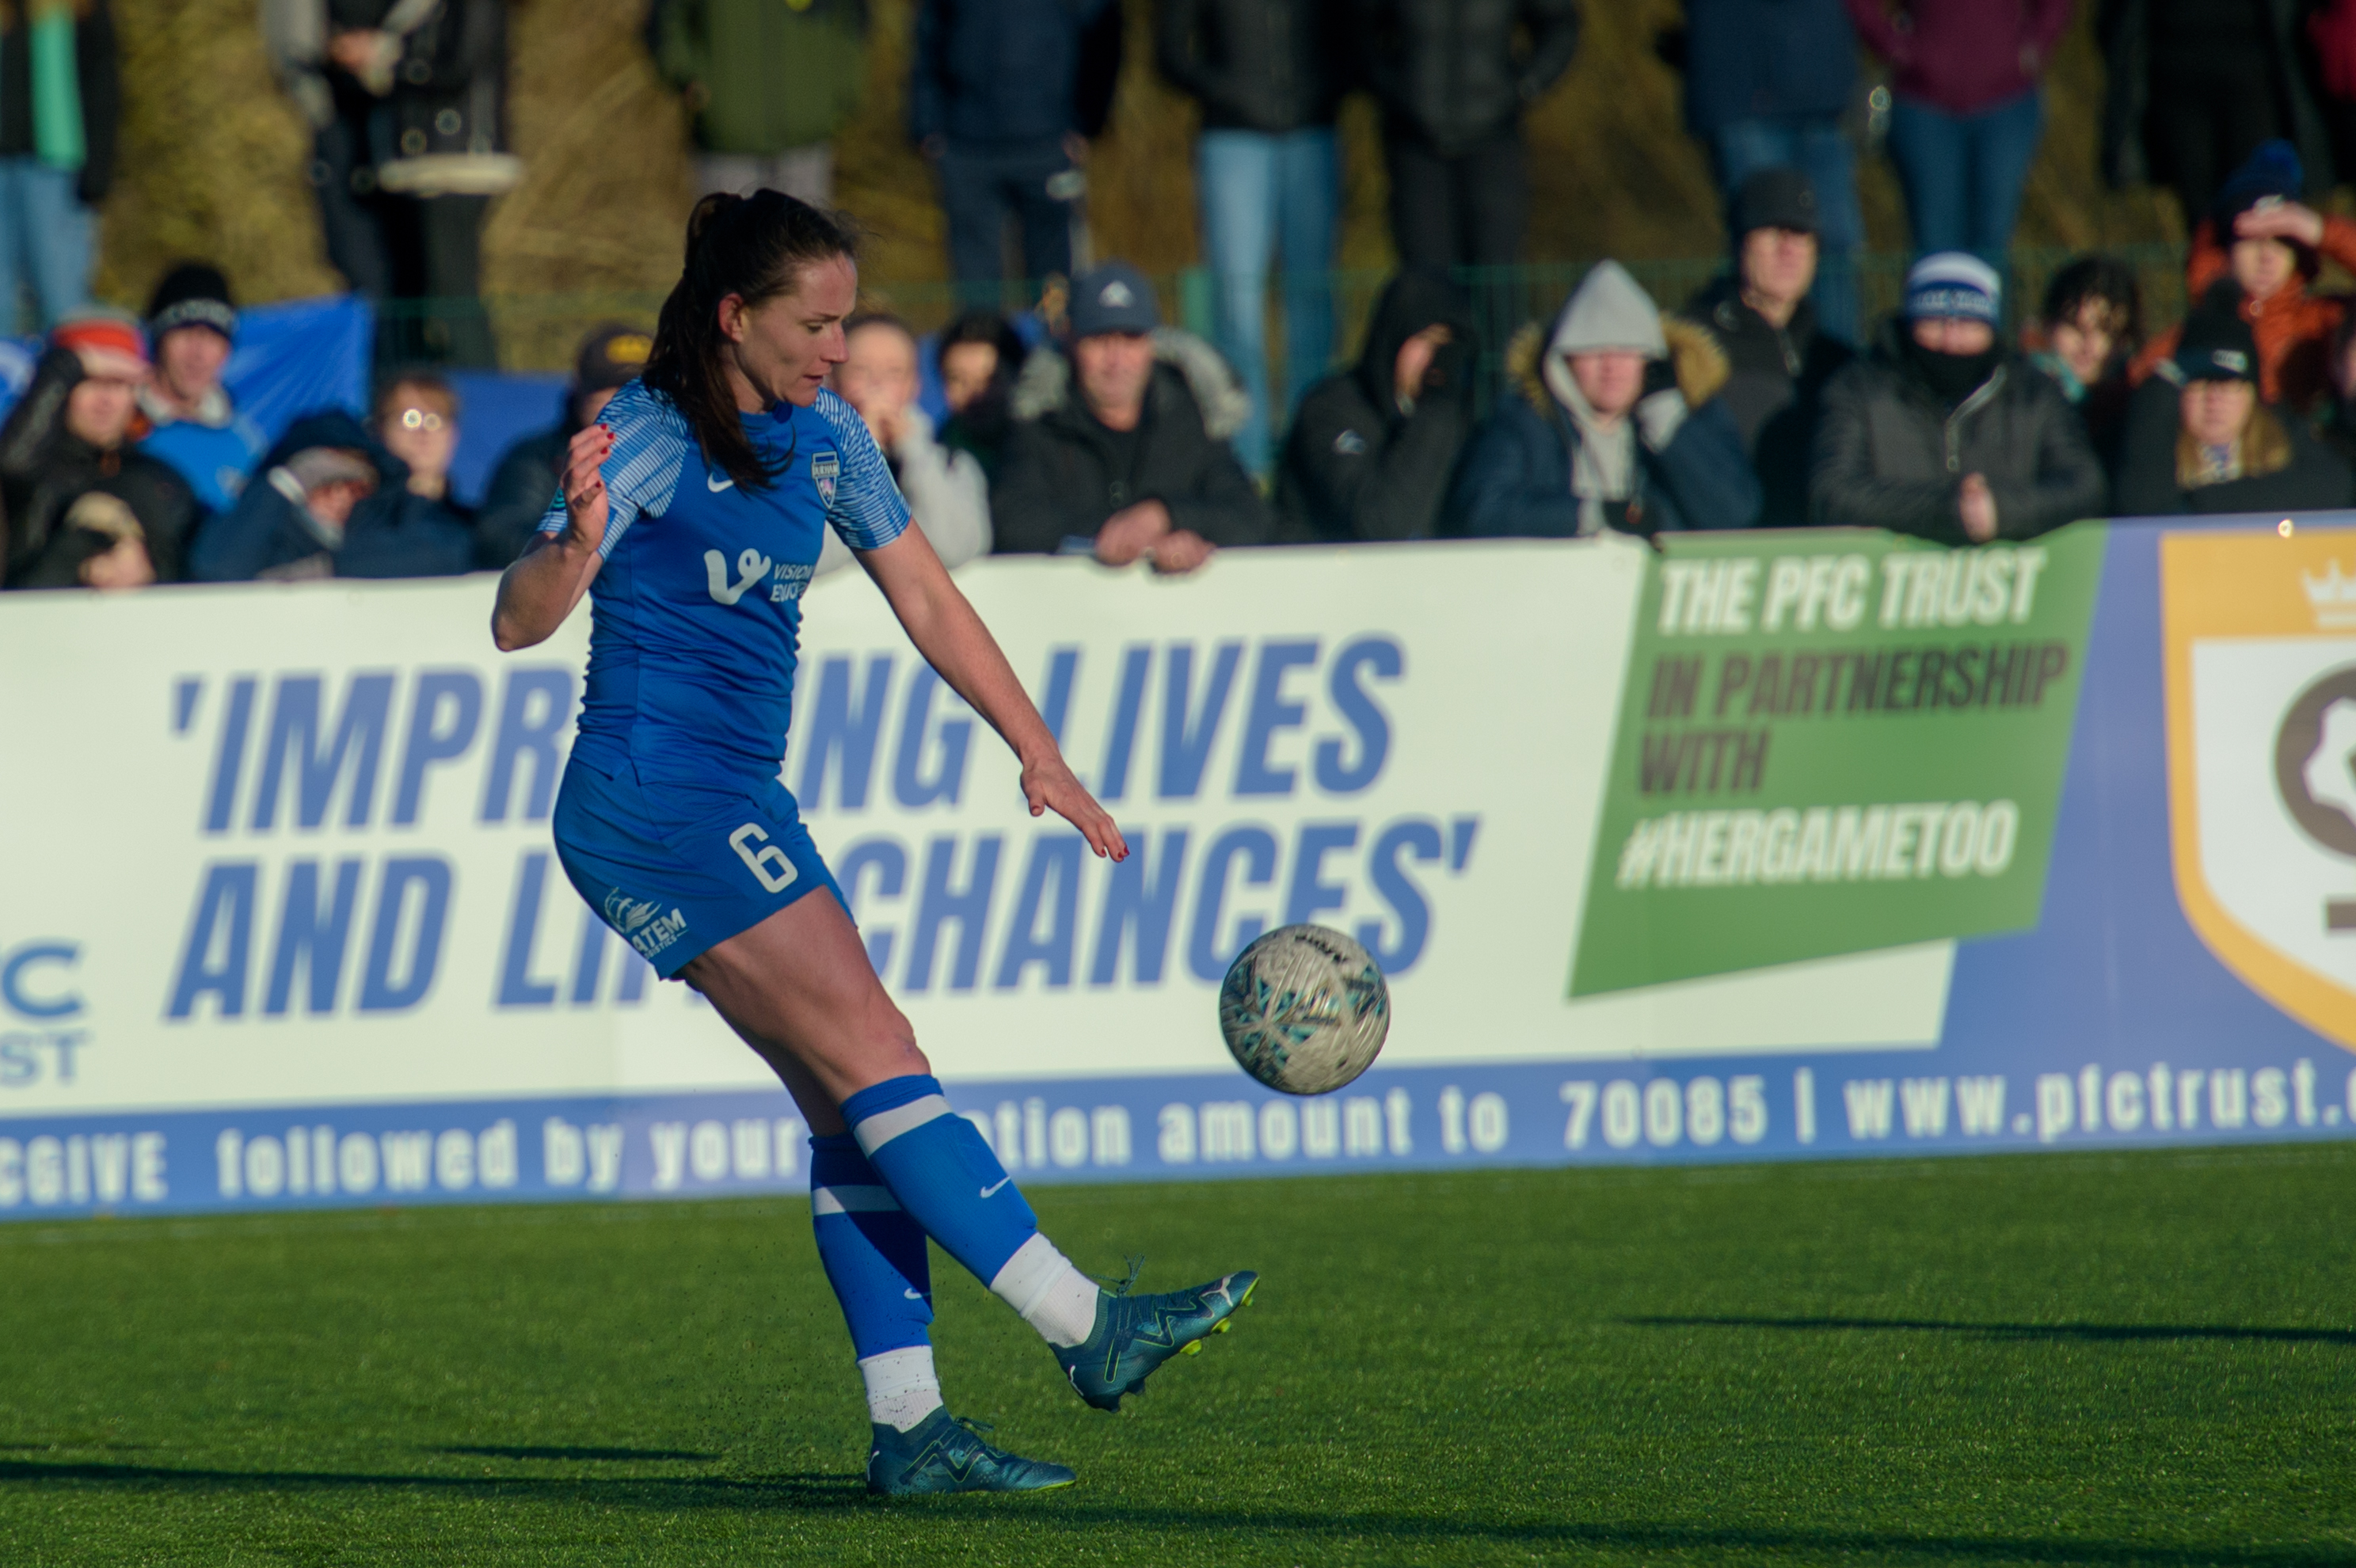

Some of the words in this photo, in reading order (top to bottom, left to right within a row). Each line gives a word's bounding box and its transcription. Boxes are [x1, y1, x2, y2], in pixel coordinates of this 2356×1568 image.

[1658, 556, 1760, 634] THE
[1762, 554, 1871, 632] PFC
[1878, 547, 2046, 630] TRUST
[1647, 652, 1705, 721] IN
[1712, 638, 2070, 718] PARTNERSHIP
[172, 656, 977, 835] 'IMPRNG
[1639, 728, 1771, 799] WITH
[729, 822, 798, 894] 6
[1616, 798, 2019, 889] #HERGAMETOO
[162, 851, 457, 1022] AND
[216, 1117, 519, 1199] followed
[545, 1116, 622, 1192] by
[649, 1119, 805, 1191] your
[1157, 1088, 1412, 1161] amount
[1440, 1085, 1507, 1153] to
[1559, 1073, 1768, 1151] 70085
